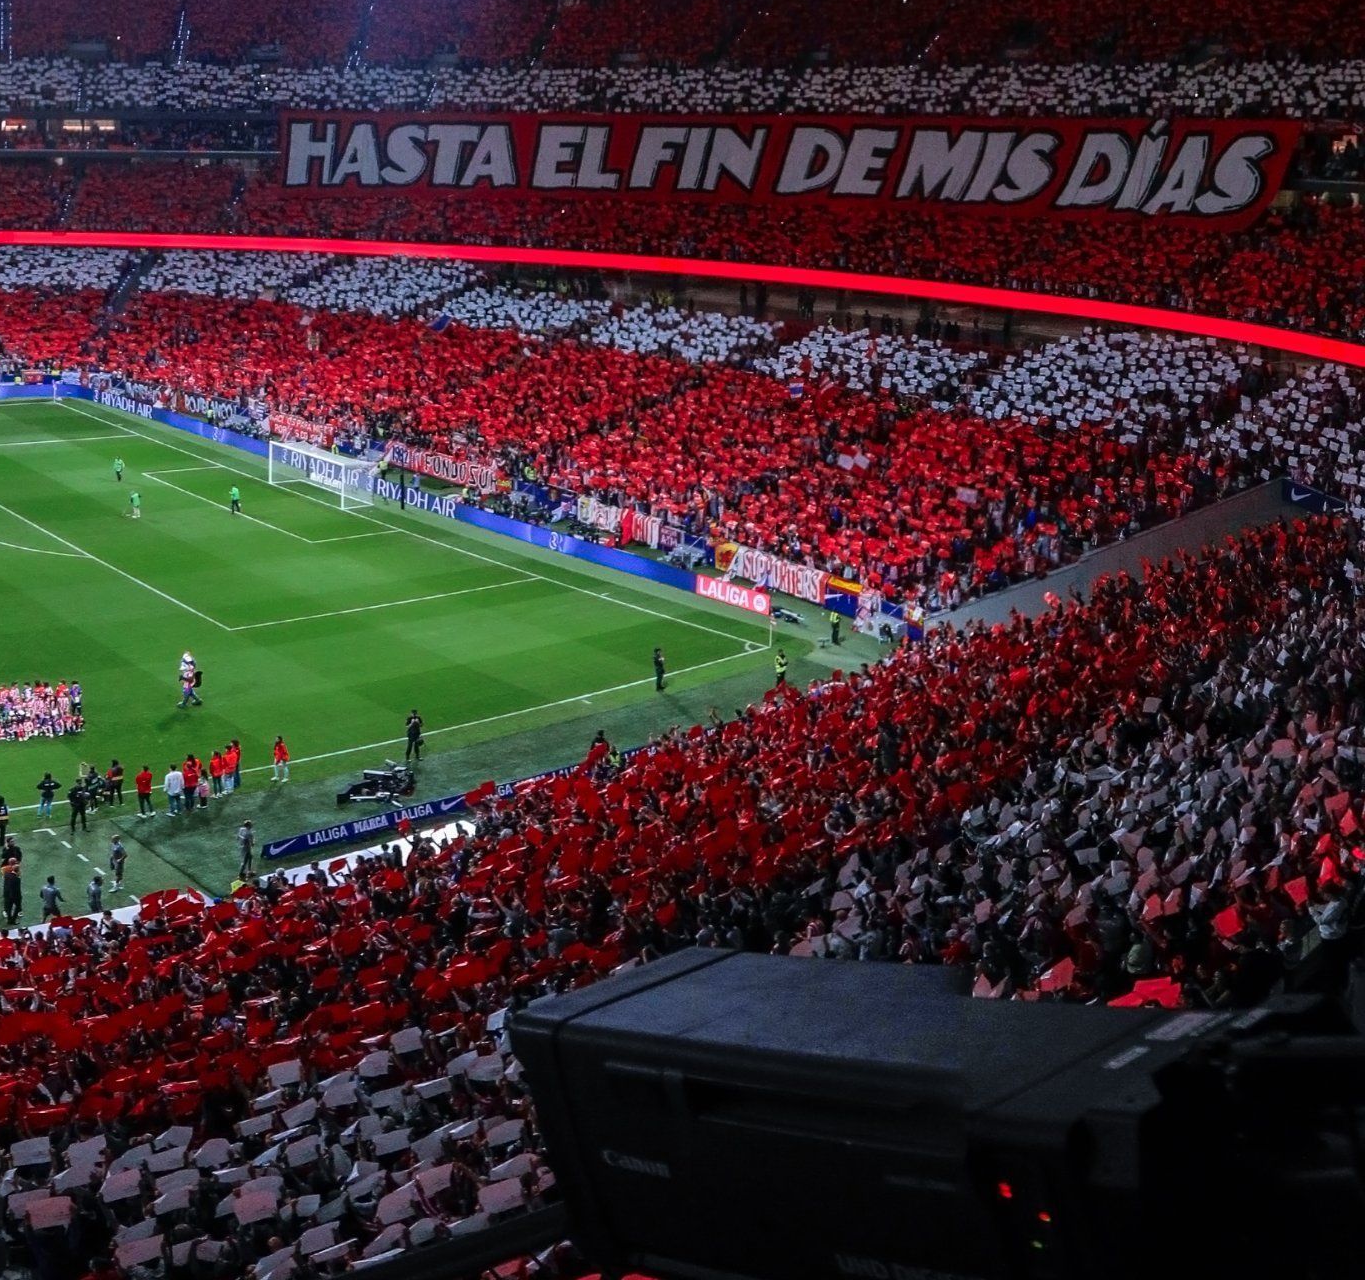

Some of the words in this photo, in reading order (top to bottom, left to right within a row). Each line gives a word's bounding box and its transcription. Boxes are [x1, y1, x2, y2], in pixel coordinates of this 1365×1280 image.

[285, 123, 517, 188] HASTA
[532, 125, 621, 190] EL
[629, 126, 766, 191] FIN
[775, 125, 898, 195] DE
[895, 128, 1060, 202] MIS
[1054, 119, 1275, 215] DÍAS
[101, 391, 136, 413] RIYADH
[136, 402, 153, 419] AIR
[290, 450, 335, 481] RIYADH
[338, 469, 360, 487] AIR
[424, 453, 468, 483] FONDO
[431, 496, 456, 519] AIR
[698, 575, 749, 609] LALIGA
[307, 826, 348, 846] LALIGA
[353, 814, 390, 834] MARCA
[394, 803, 435, 824] LALIGA
[600, 1149, 669, 1178] Canon
